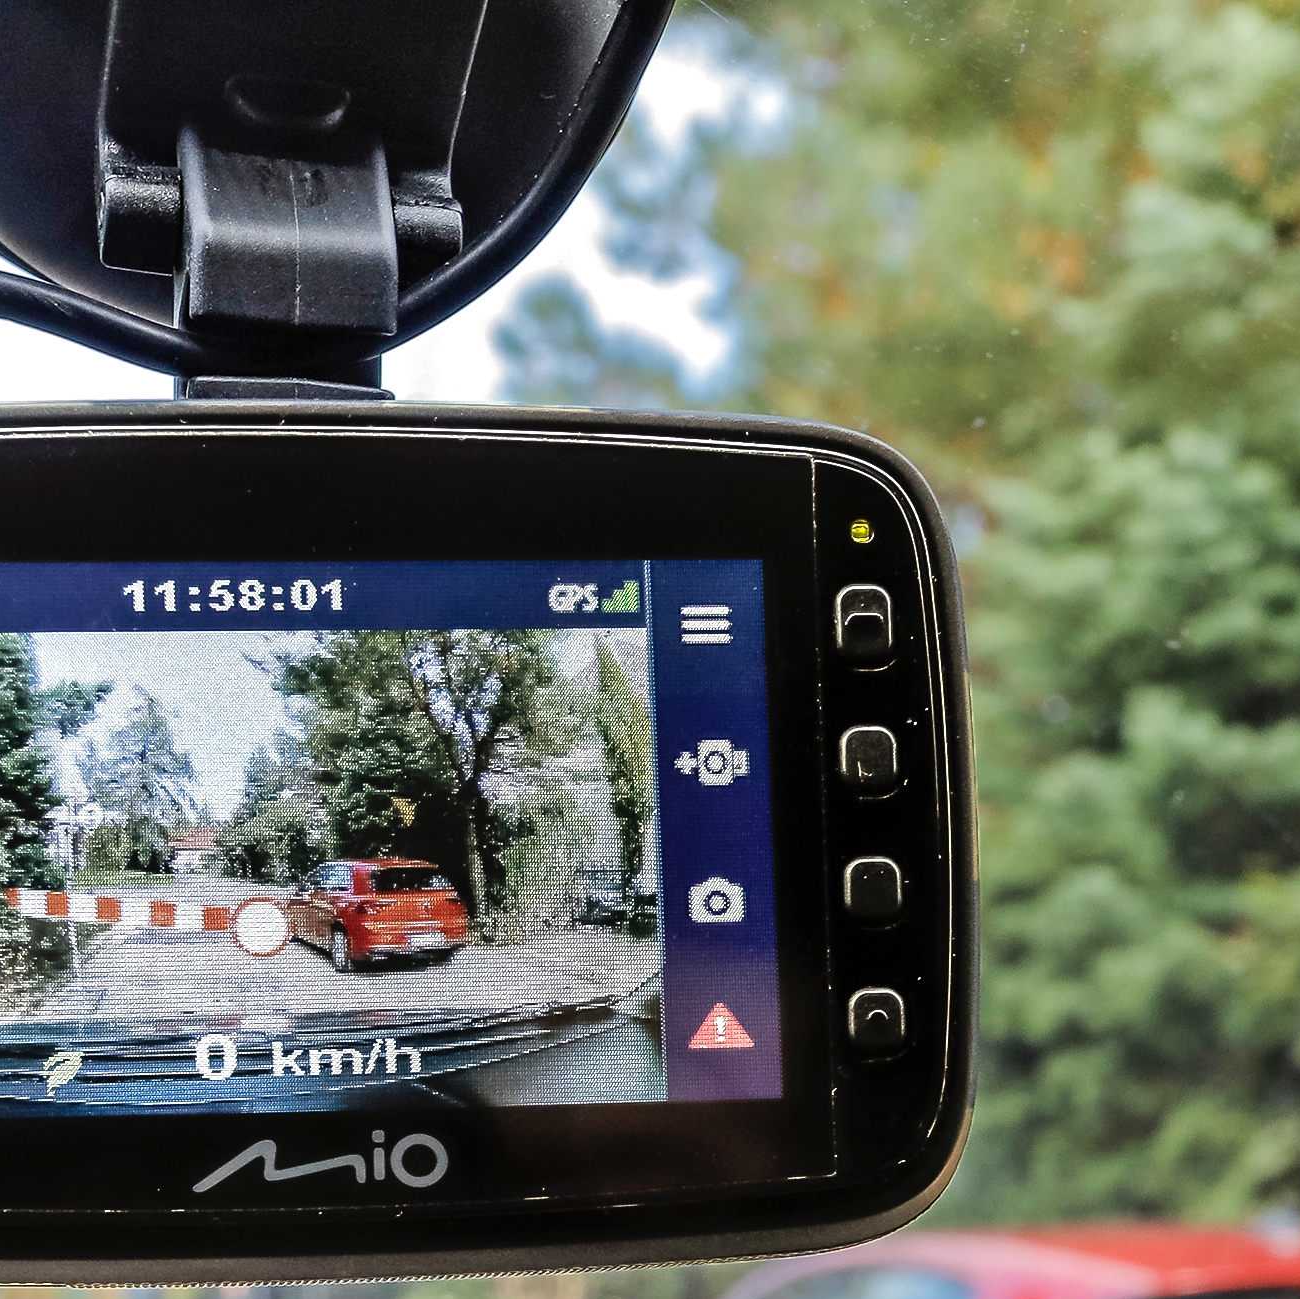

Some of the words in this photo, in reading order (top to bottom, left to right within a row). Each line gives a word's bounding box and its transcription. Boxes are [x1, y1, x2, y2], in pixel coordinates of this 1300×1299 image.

[122, 578, 344, 612] 11:58:01
[548, 583, 599, 613] GPS
[194, 1033, 238, 1081] 0
[272, 1038, 423, 1077] km/h
